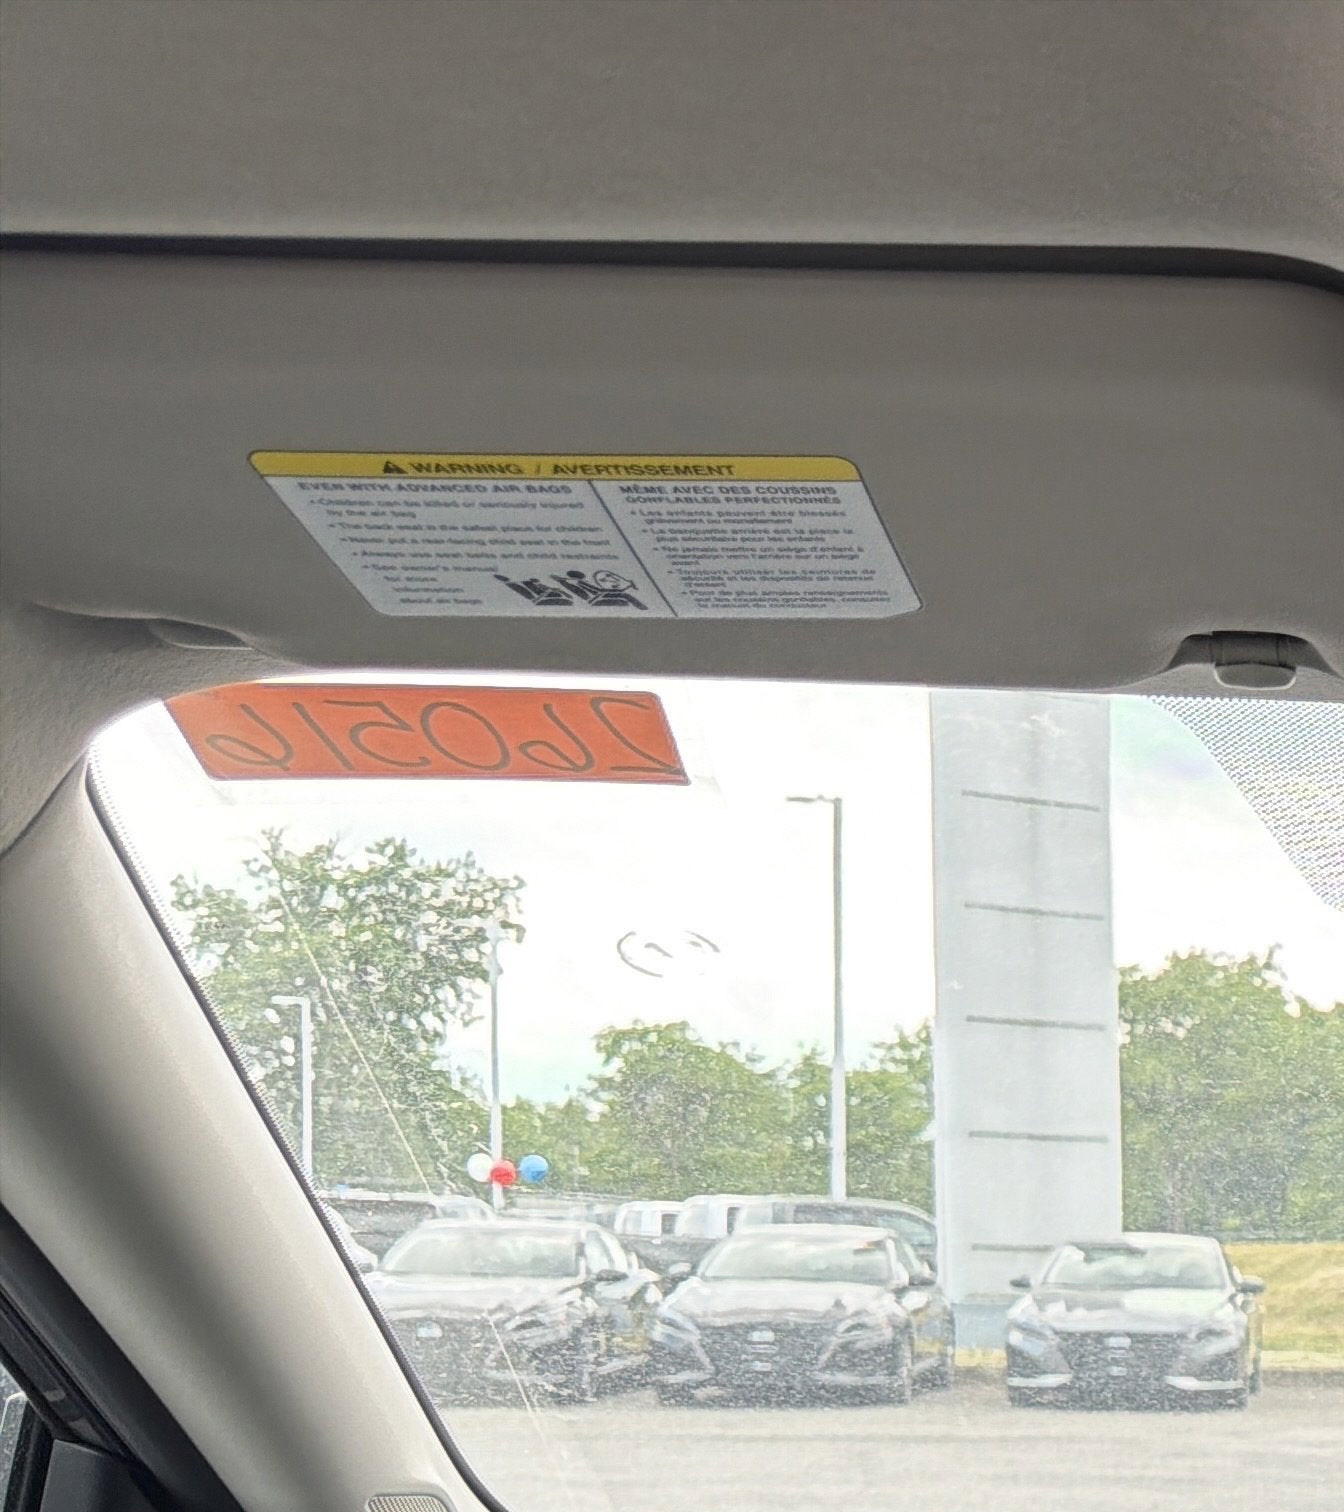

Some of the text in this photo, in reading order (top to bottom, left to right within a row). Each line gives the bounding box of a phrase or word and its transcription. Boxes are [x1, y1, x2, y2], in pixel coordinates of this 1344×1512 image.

[410, 463, 737, 476] WARNING AVERTISSEMENT
[298, 481, 573, 494] EVEN WITH ADVANCED AIR BAGS
